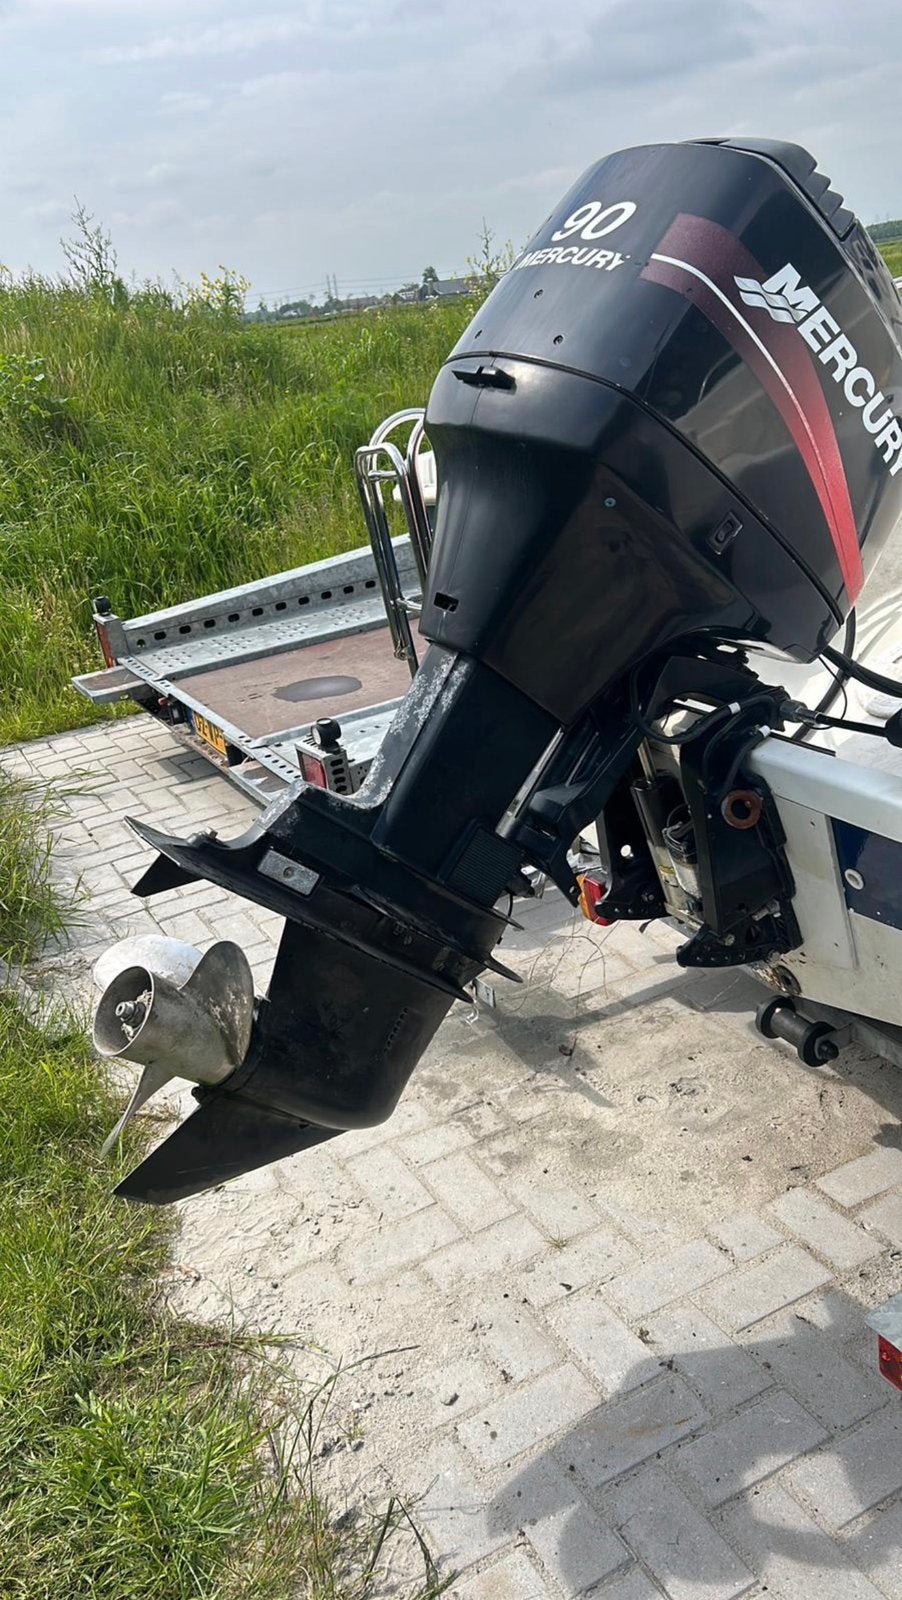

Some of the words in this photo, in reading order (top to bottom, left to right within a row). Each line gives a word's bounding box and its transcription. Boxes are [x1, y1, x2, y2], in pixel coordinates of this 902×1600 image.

[551, 201, 637, 242] 90
[515, 246, 625, 271] MERCURY
[761, 262, 902, 477] MERCURY
